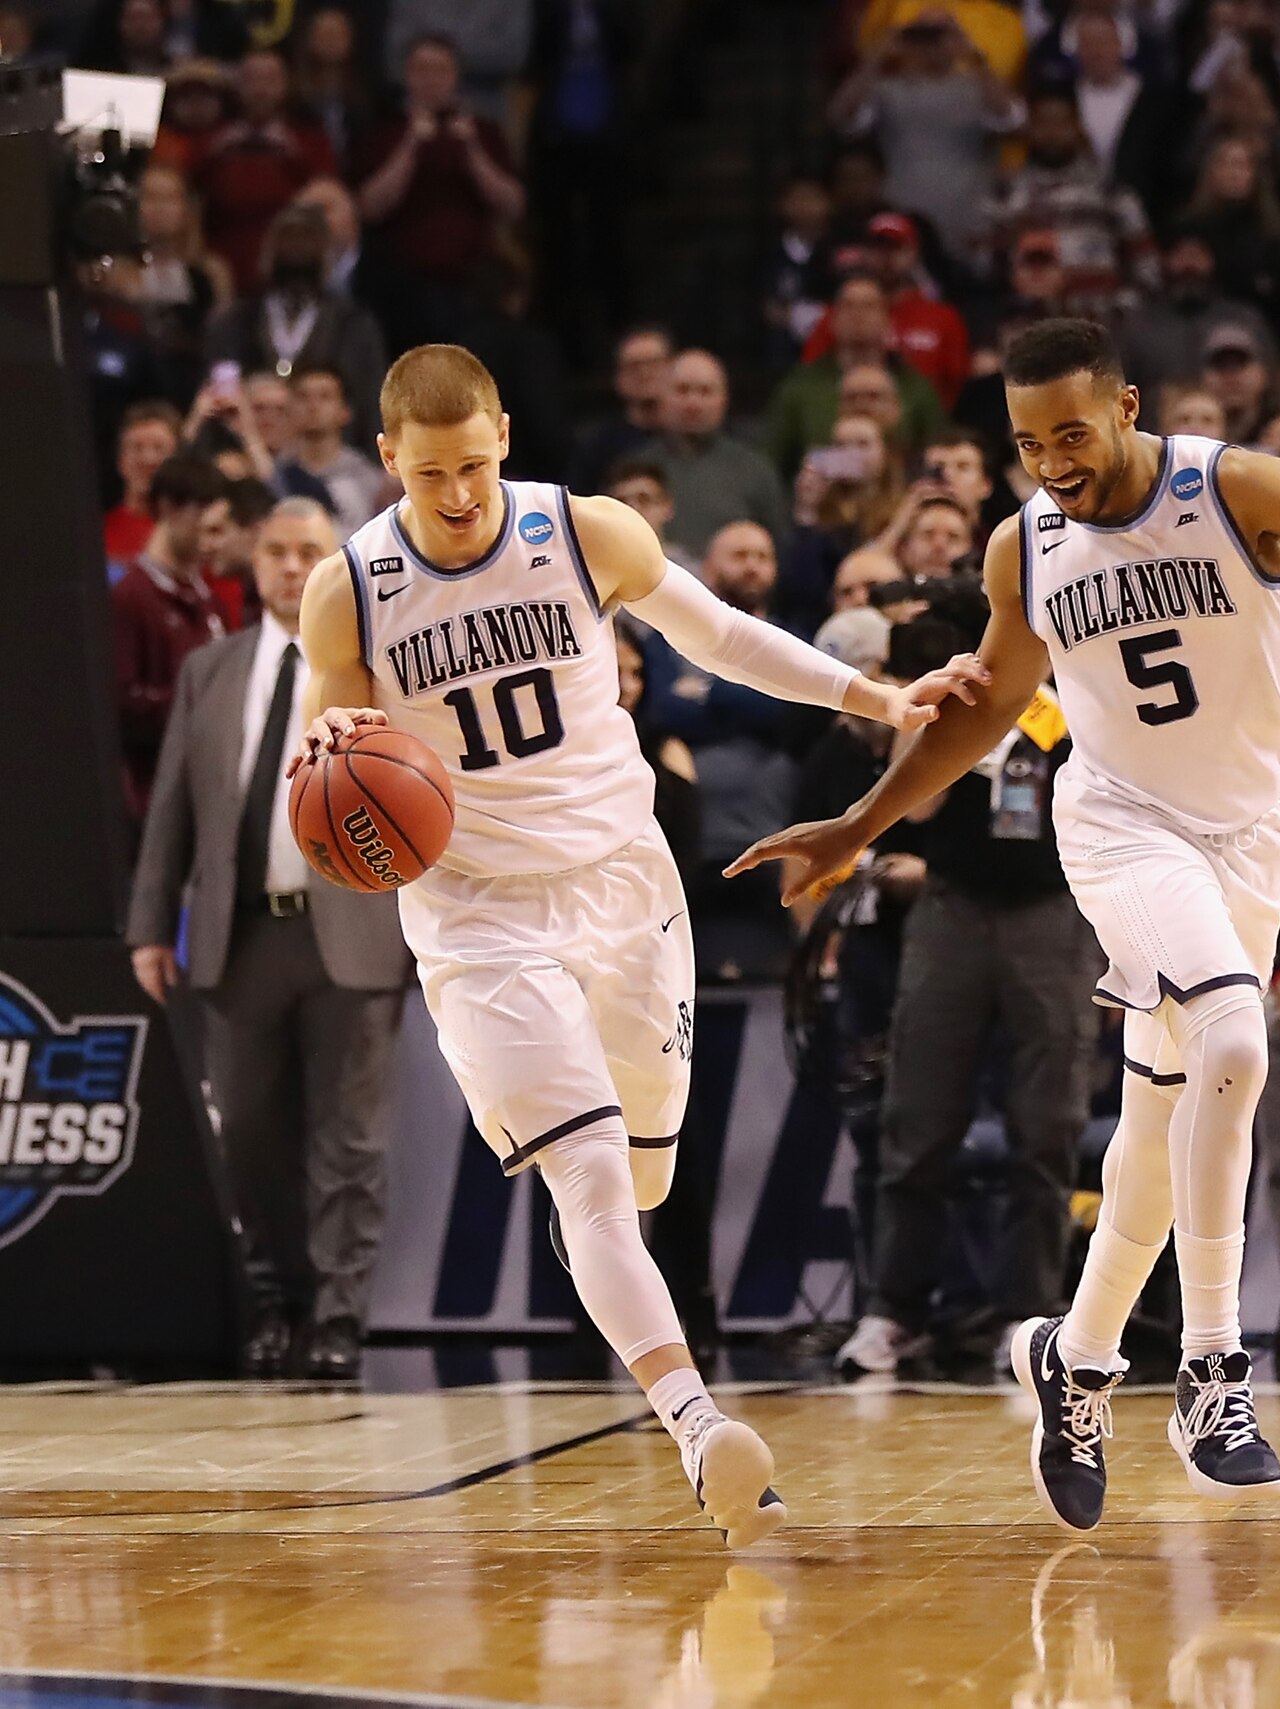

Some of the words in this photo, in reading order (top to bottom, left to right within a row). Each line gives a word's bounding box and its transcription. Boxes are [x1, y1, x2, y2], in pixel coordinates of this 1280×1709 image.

[373, 560, 399, 572] RVM
[1039, 514, 1061, 529] RVM
[386, 600, 584, 698] VILLANOVA
[1045, 557, 1238, 653] VILLANOVA
[443, 667, 566, 771] 10
[1118, 628, 1200, 726] 5
